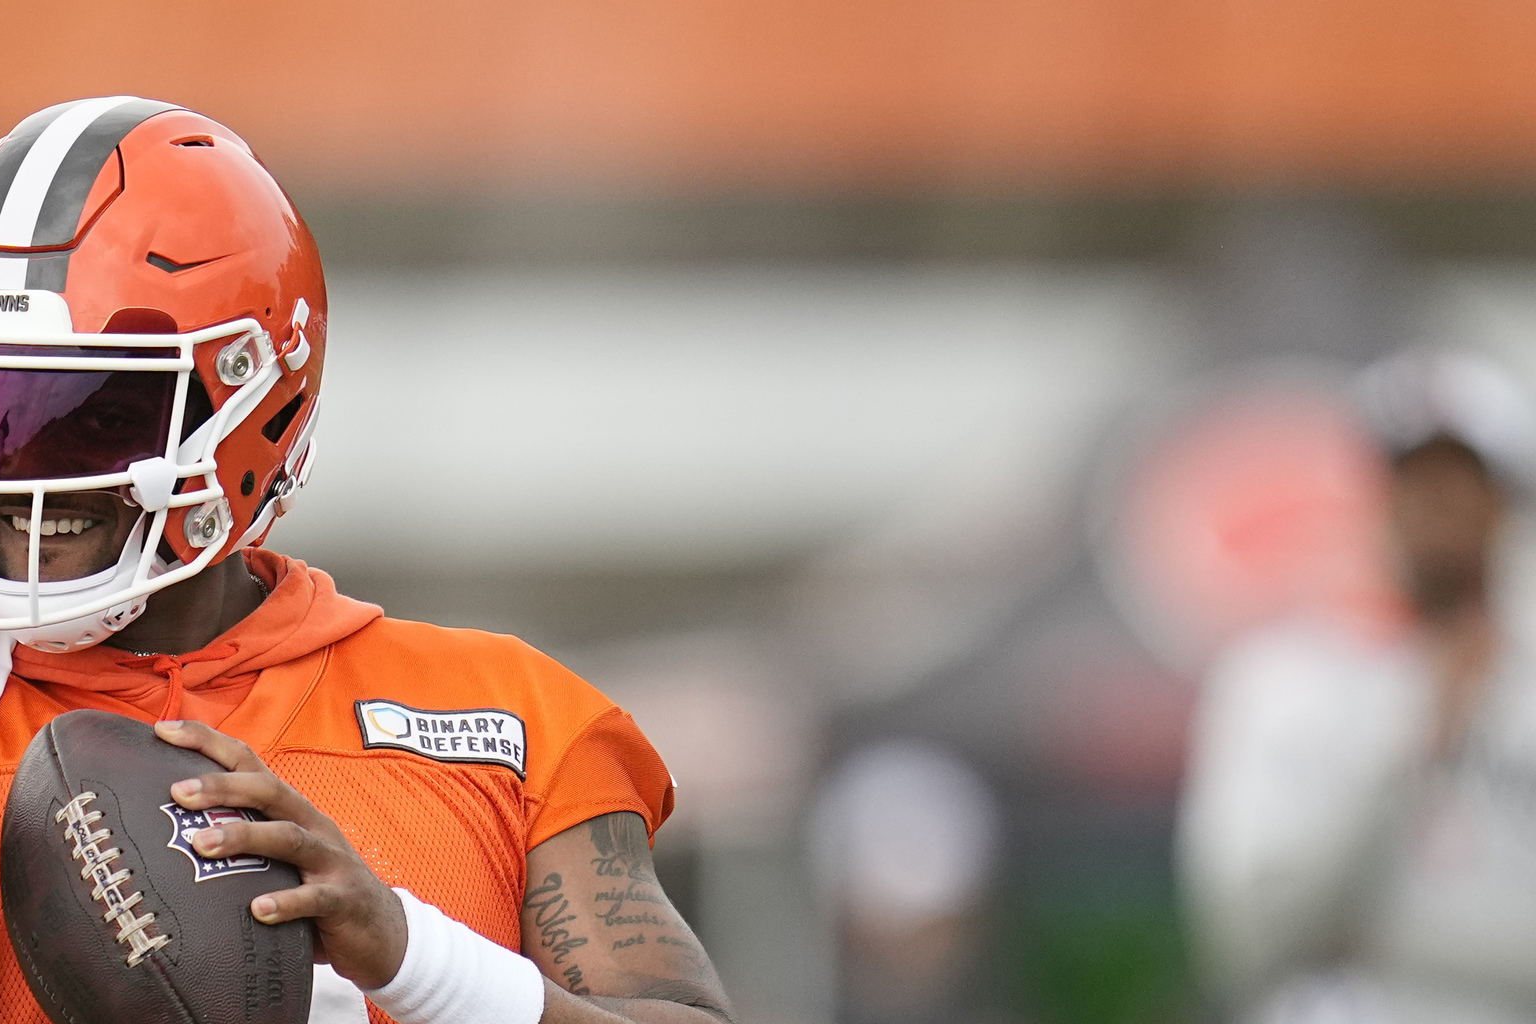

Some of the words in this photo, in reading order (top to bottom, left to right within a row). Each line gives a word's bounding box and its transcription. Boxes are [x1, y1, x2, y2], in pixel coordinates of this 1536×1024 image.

[415, 717, 505, 734] BINARY
[418, 734, 522, 765] DEFENSE
[525, 871, 588, 965] Wish
